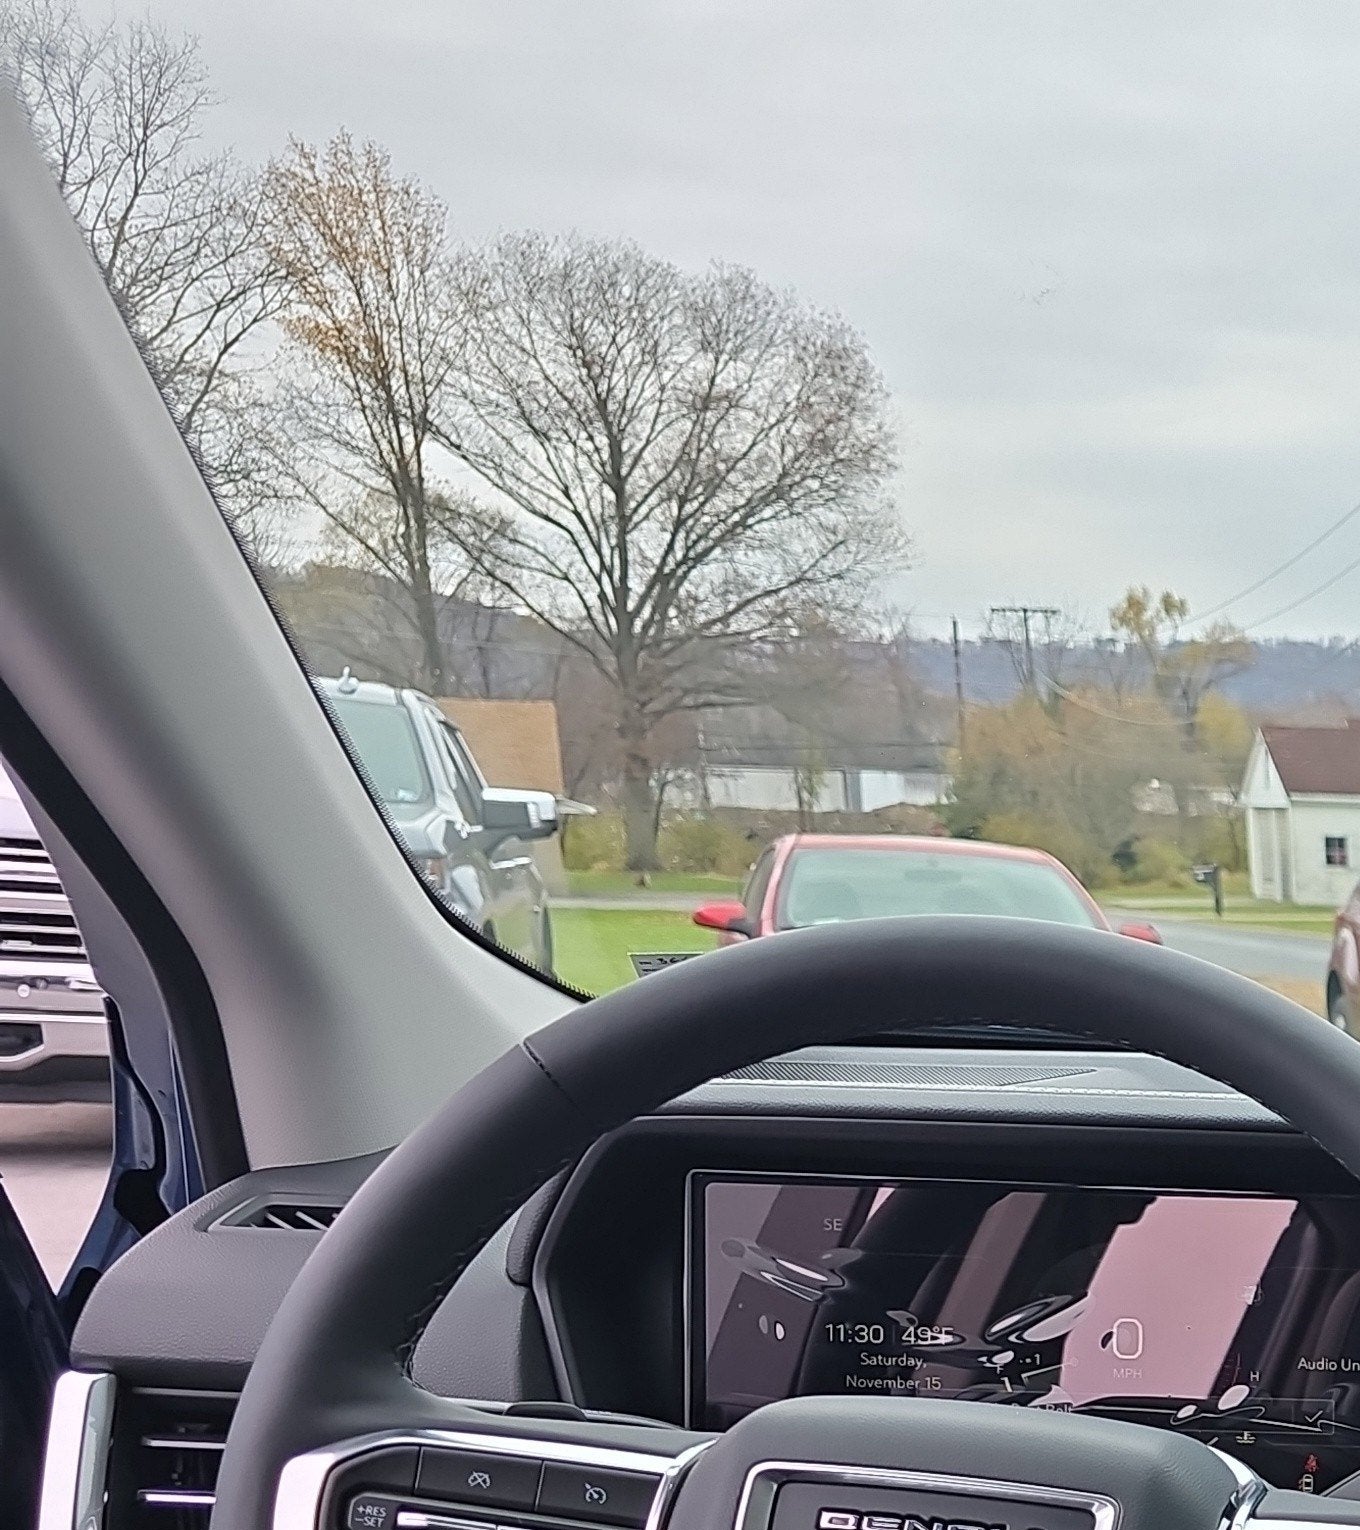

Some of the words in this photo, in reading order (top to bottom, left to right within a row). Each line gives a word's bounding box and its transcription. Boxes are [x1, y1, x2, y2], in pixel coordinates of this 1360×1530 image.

[823, 1218, 842, 1232] SE
[825, 1323, 884, 1344] 11:30
[1112, 1318, 1144, 1360] 0
[860, 1352, 927, 1370] Saturday,
[1297, 1357, 1338, 1372] Audio
[1112, 1368, 1143, 1379] MPH
[1250, 1371, 1260, 1381] H
[846, 1375, 920, 1390] November
[924, 1376, 942, 1390] 15
